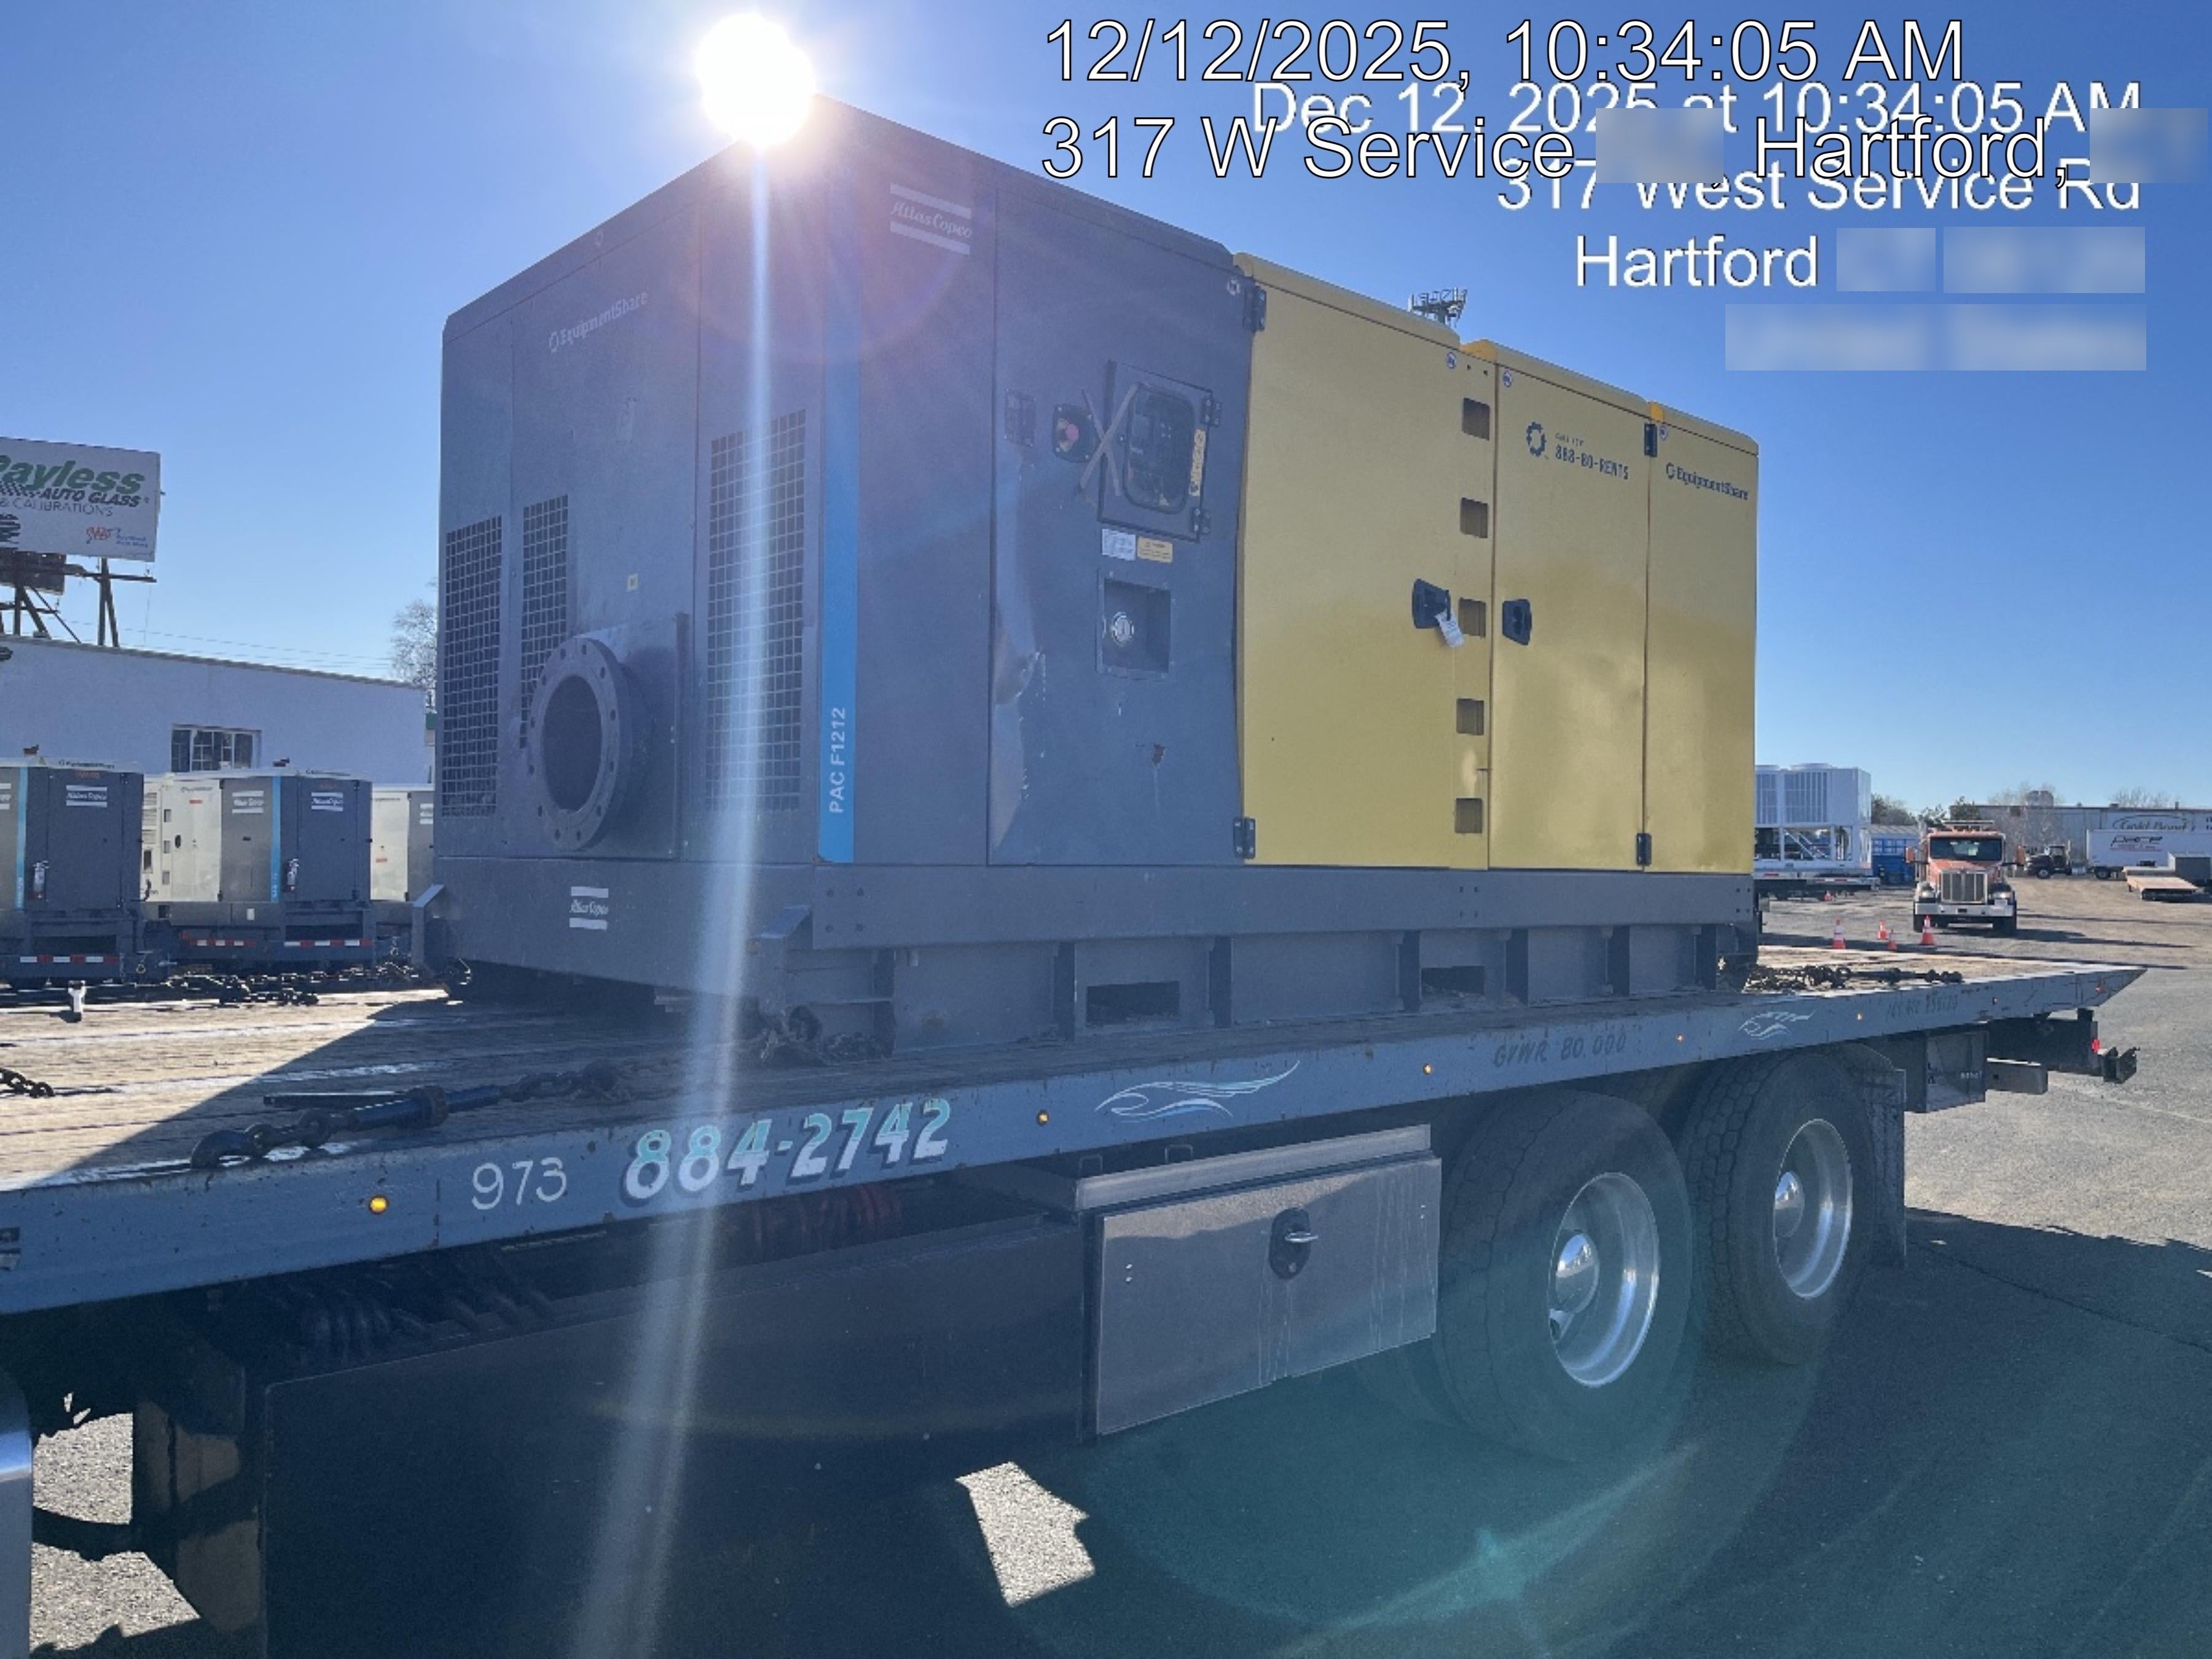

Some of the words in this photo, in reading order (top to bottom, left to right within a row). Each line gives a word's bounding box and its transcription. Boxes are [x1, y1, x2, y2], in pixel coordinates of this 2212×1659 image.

[560, 291, 648, 345] EquipmentShare
[12, 498, 113, 517] CALIBRATIONS
[39, 488, 85, 502] AUTO
[88, 491, 141, 508] GLASS
[830, 707, 845, 766] F1212
[830, 771, 845, 813] PAC
[471, 1156, 568, 1210] 973
[623, 1098, 952, 1201] 884-2742
